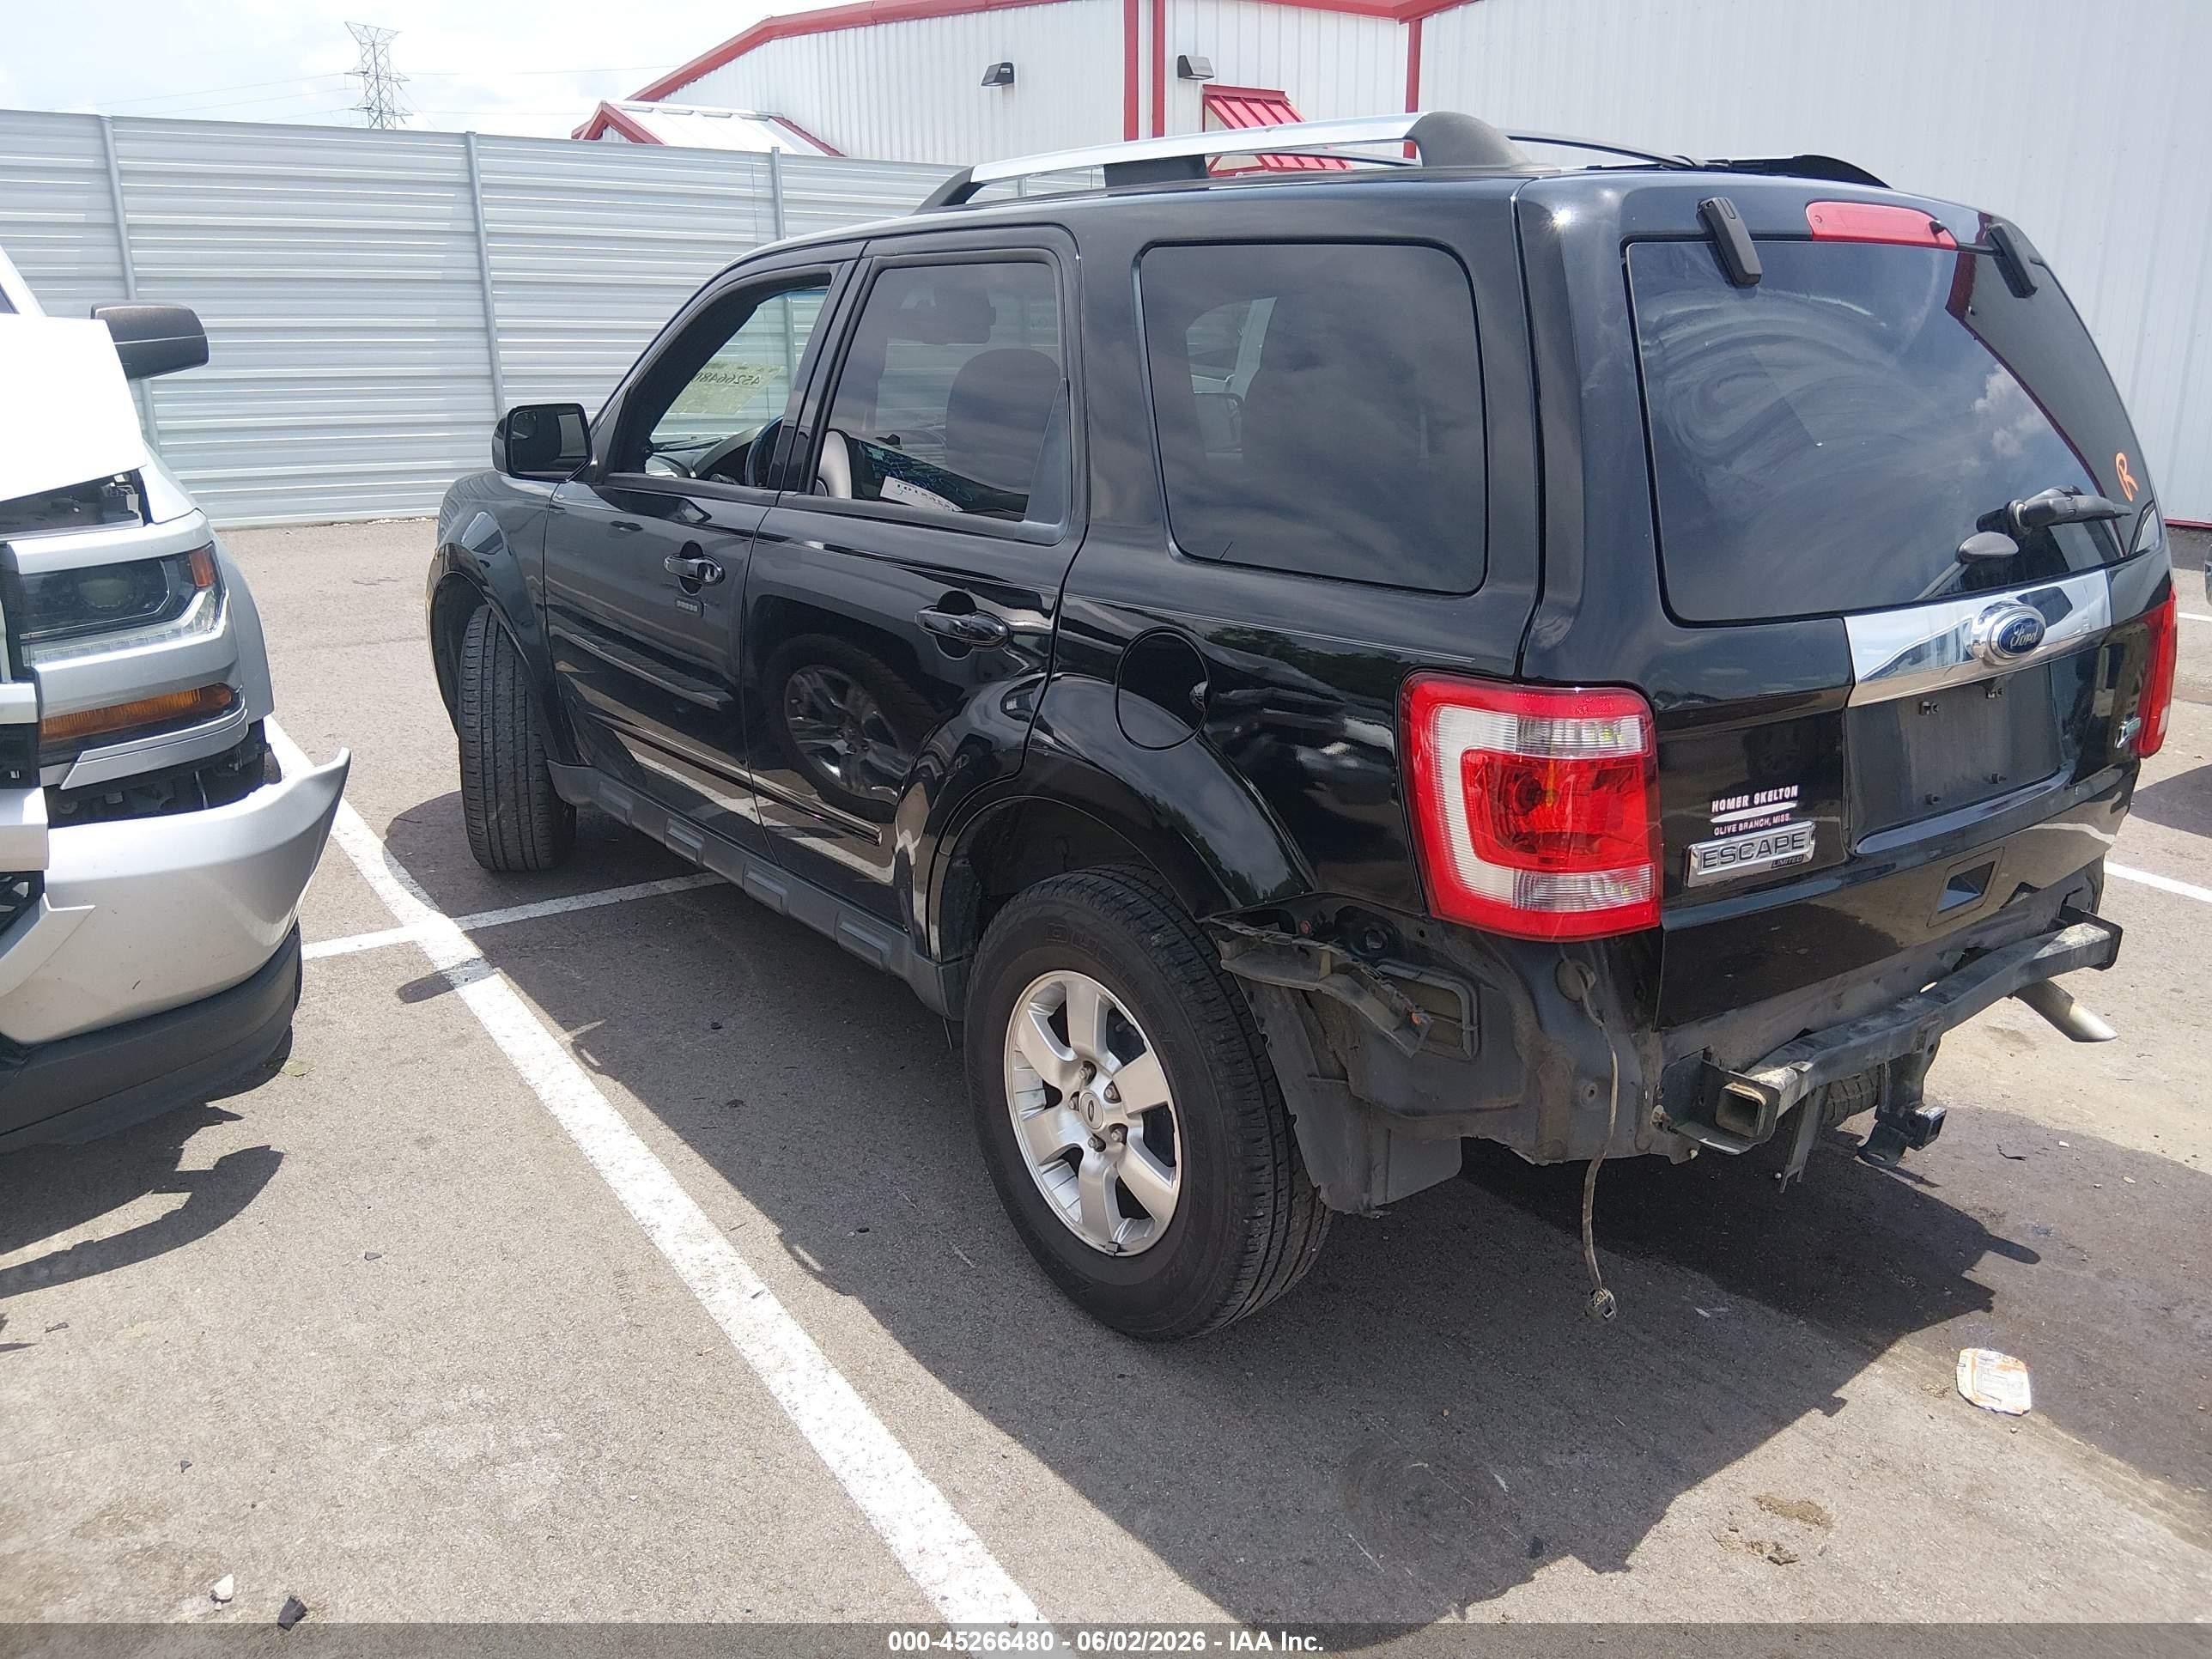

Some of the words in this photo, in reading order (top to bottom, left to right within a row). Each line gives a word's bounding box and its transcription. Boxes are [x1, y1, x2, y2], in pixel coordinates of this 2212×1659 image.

[2115, 452, 2139, 502] R
[2009, 622, 2039, 650] Ford
[1711, 794, 1750, 813] HOMER
[1753, 785, 1799, 805] SKELTON
[1714, 823, 1737, 836] OLIVE
[1702, 830, 1808, 869] ESCAPE
[1771, 855, 1803, 869] LIMITED
